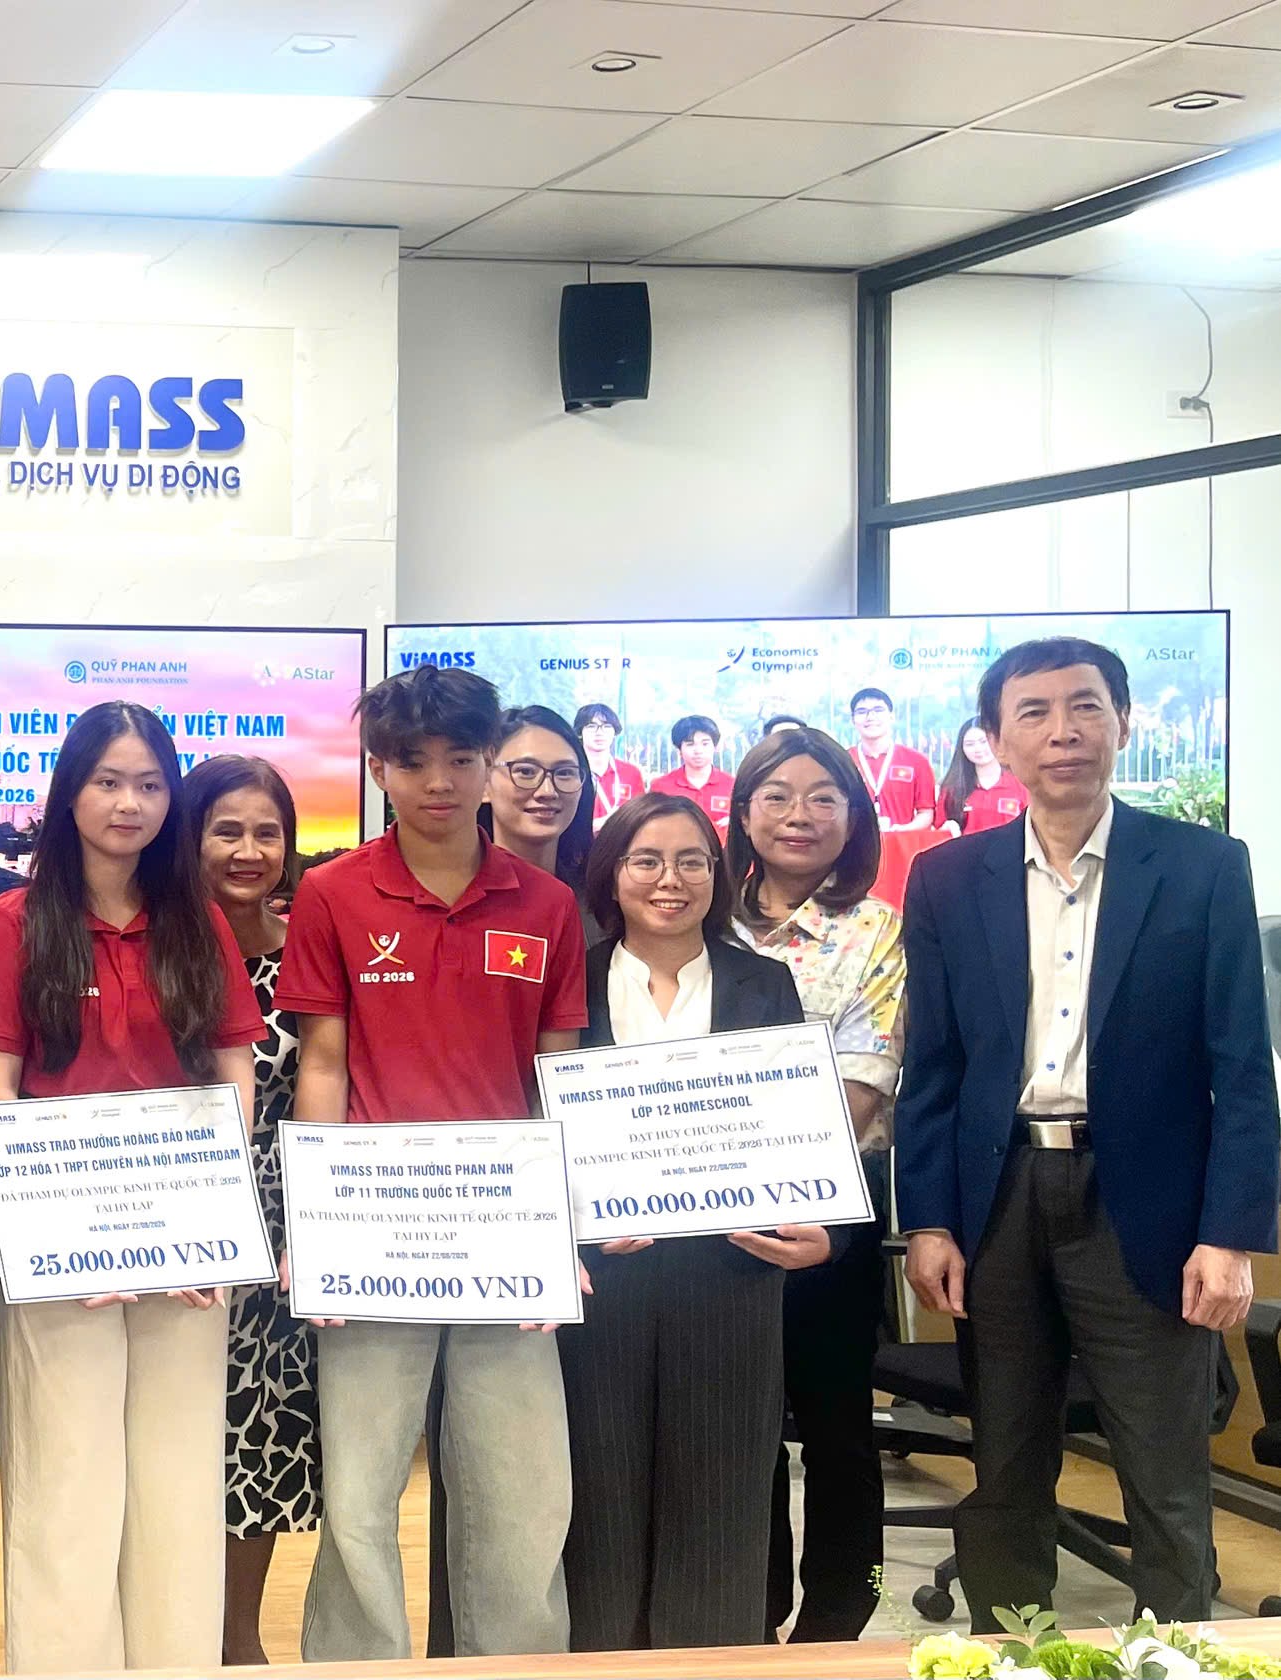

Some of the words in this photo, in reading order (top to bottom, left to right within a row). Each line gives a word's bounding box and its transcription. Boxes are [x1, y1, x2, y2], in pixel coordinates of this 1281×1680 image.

[10, 461, 73, 490] DỊCH
[83, 464, 118, 491] VỤ
[129, 464, 152, 487] DI
[161, 461, 240, 493] ĐỘNG
[752, 647, 819, 658] Economics
[1146, 648, 1195, 661] AStar
[91, 659, 117, 673] QUỸ
[121, 661, 156, 672] PHAN
[160, 662, 187, 672] ANH
[540, 658, 590, 670] GENIUS
[752, 661, 813, 673] Olympiad
[293, 667, 335, 680] AStar
[10, 708, 57, 734] VIÊN
[184, 710, 228, 740] VIỆT
[236, 715, 284, 736] NAM
[359, 973, 379, 983] IEO
[383, 972, 415, 983] 2026
[632, 1105, 653, 1118] LỚP
[657, 1104, 670, 1116] 12
[674, 1096, 752, 1114] HOMESCHOOL
[330, 1165, 372, 1176] VIMASS
[376, 1166, 403, 1176] TRAO
[455, 1164, 486, 1175] PHAN
[490, 1164, 513, 1174] ANH
[335, 1185, 355, 1197] LỚP
[359, 1188, 370, 1198] 11
[375, 1187, 419, 1198] TRƯỜNG
[422, 1185, 452, 1199] QUỐC
[455, 1184, 468, 1197] TẾ
[472, 1186, 511, 1197] TPHCM
[591, 1187, 754, 1219] 100.000.000
[762, 1179, 837, 1204] VND
[30, 1246, 165, 1276] 25.000.000
[172, 1240, 239, 1264] VND
[321, 1274, 463, 1298] 25.000.000
[471, 1276, 543, 1298] VND
